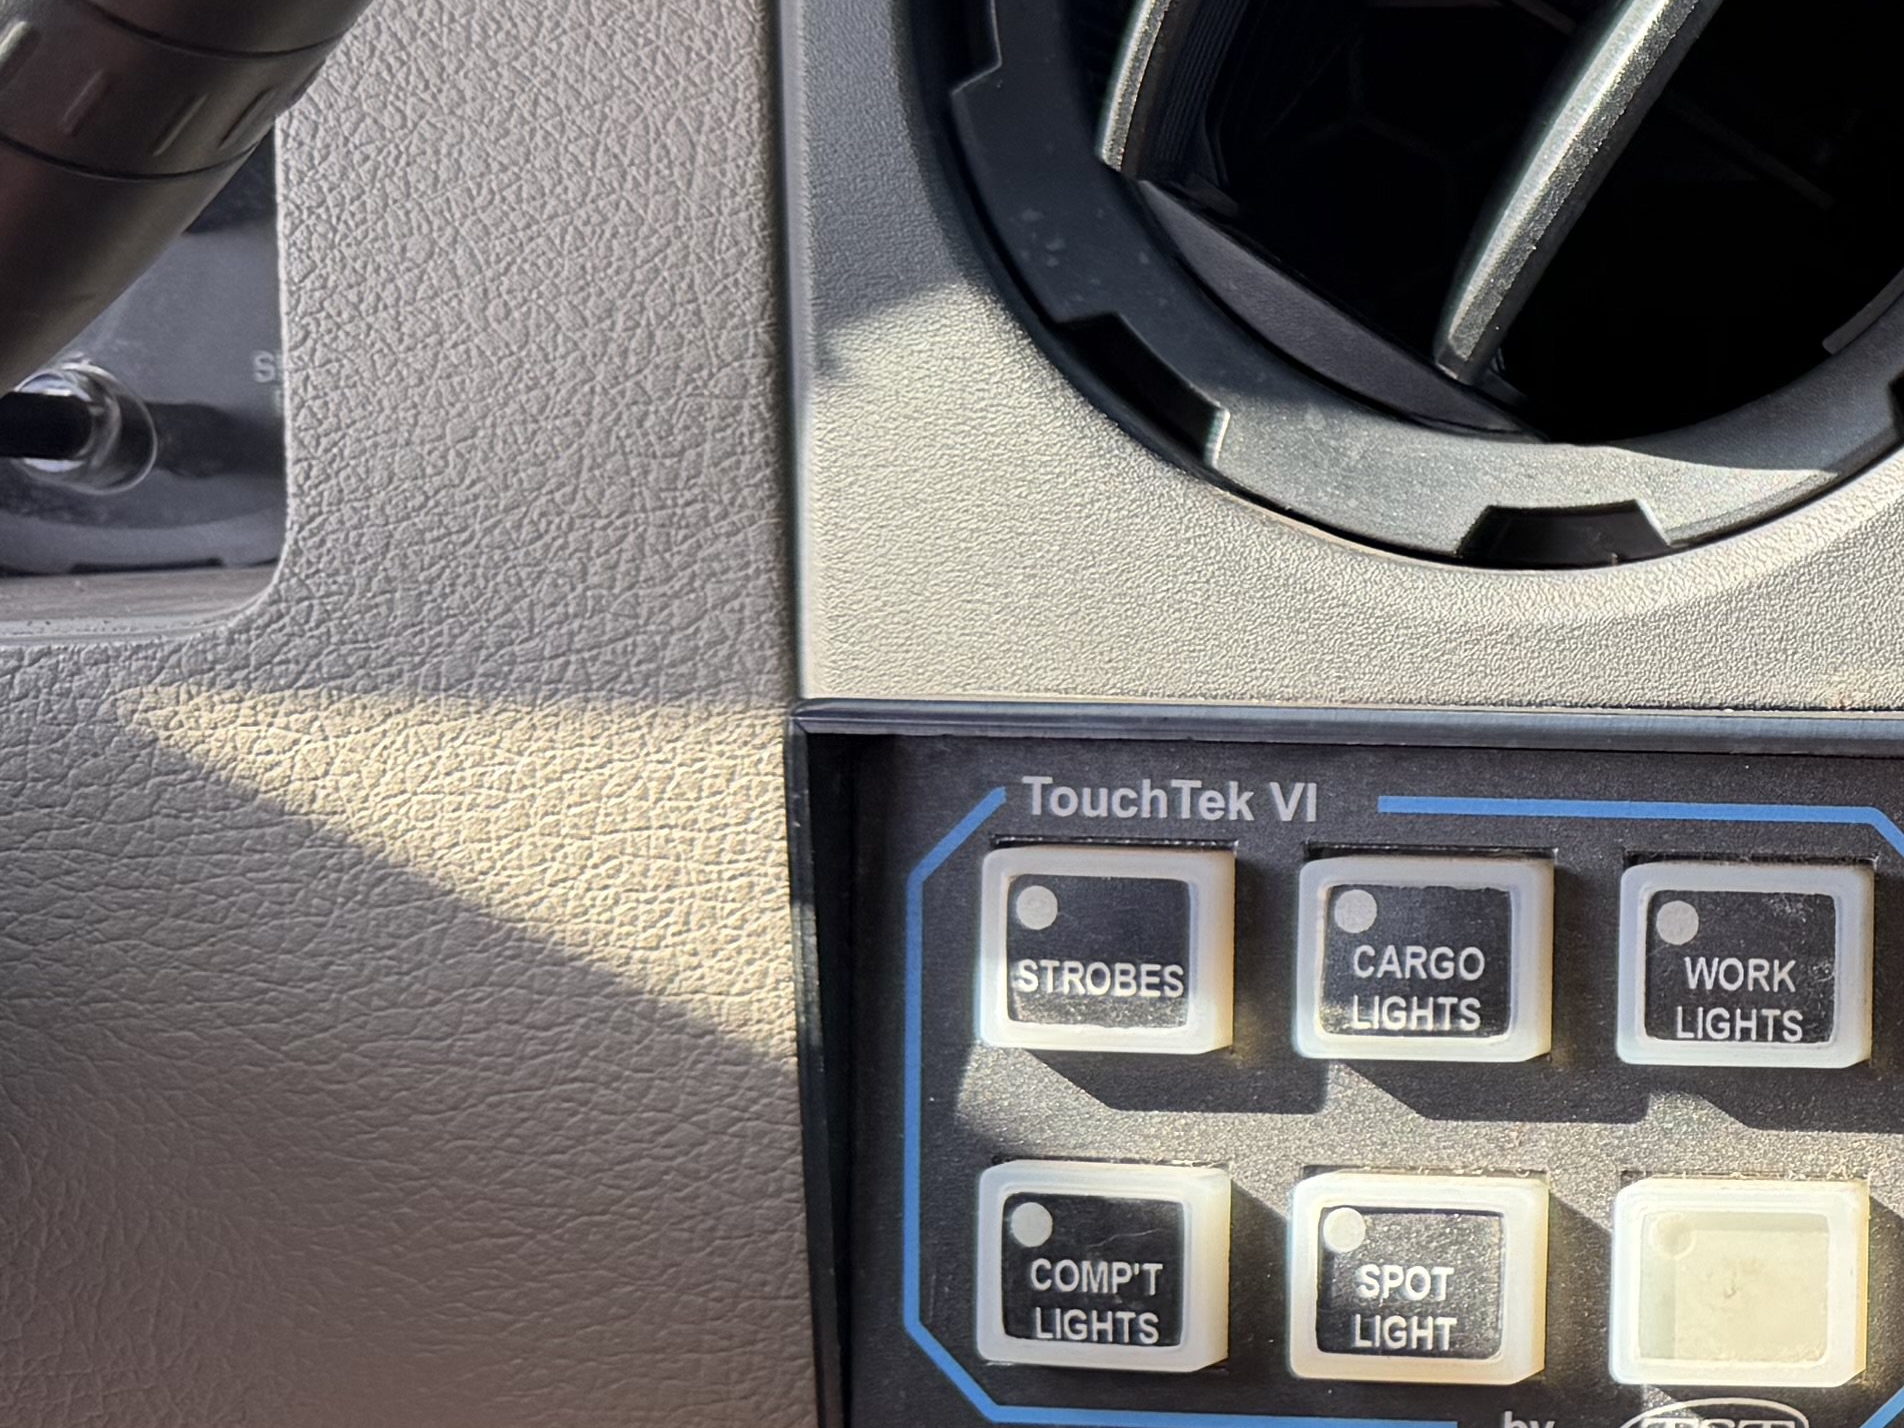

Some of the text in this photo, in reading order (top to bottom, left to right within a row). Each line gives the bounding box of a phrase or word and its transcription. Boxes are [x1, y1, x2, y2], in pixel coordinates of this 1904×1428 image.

[1022, 776, 1316, 822] TouchTek VI
[1016, 958, 1186, 999] STROBES
[1351, 945, 1484, 980] CARGO
[1684, 957, 1795, 992] WORK
[1349, 994, 1482, 1034] LIGHTS
[1675, 1004, 1804, 1045] LIGHTS
[1030, 1258, 1163, 1295] COMP'T
[1356, 1264, 1454, 1302] SPOT
[1034, 1307, 1160, 1347] LIGHTS
[1353, 1314, 1458, 1353] LIGHT
